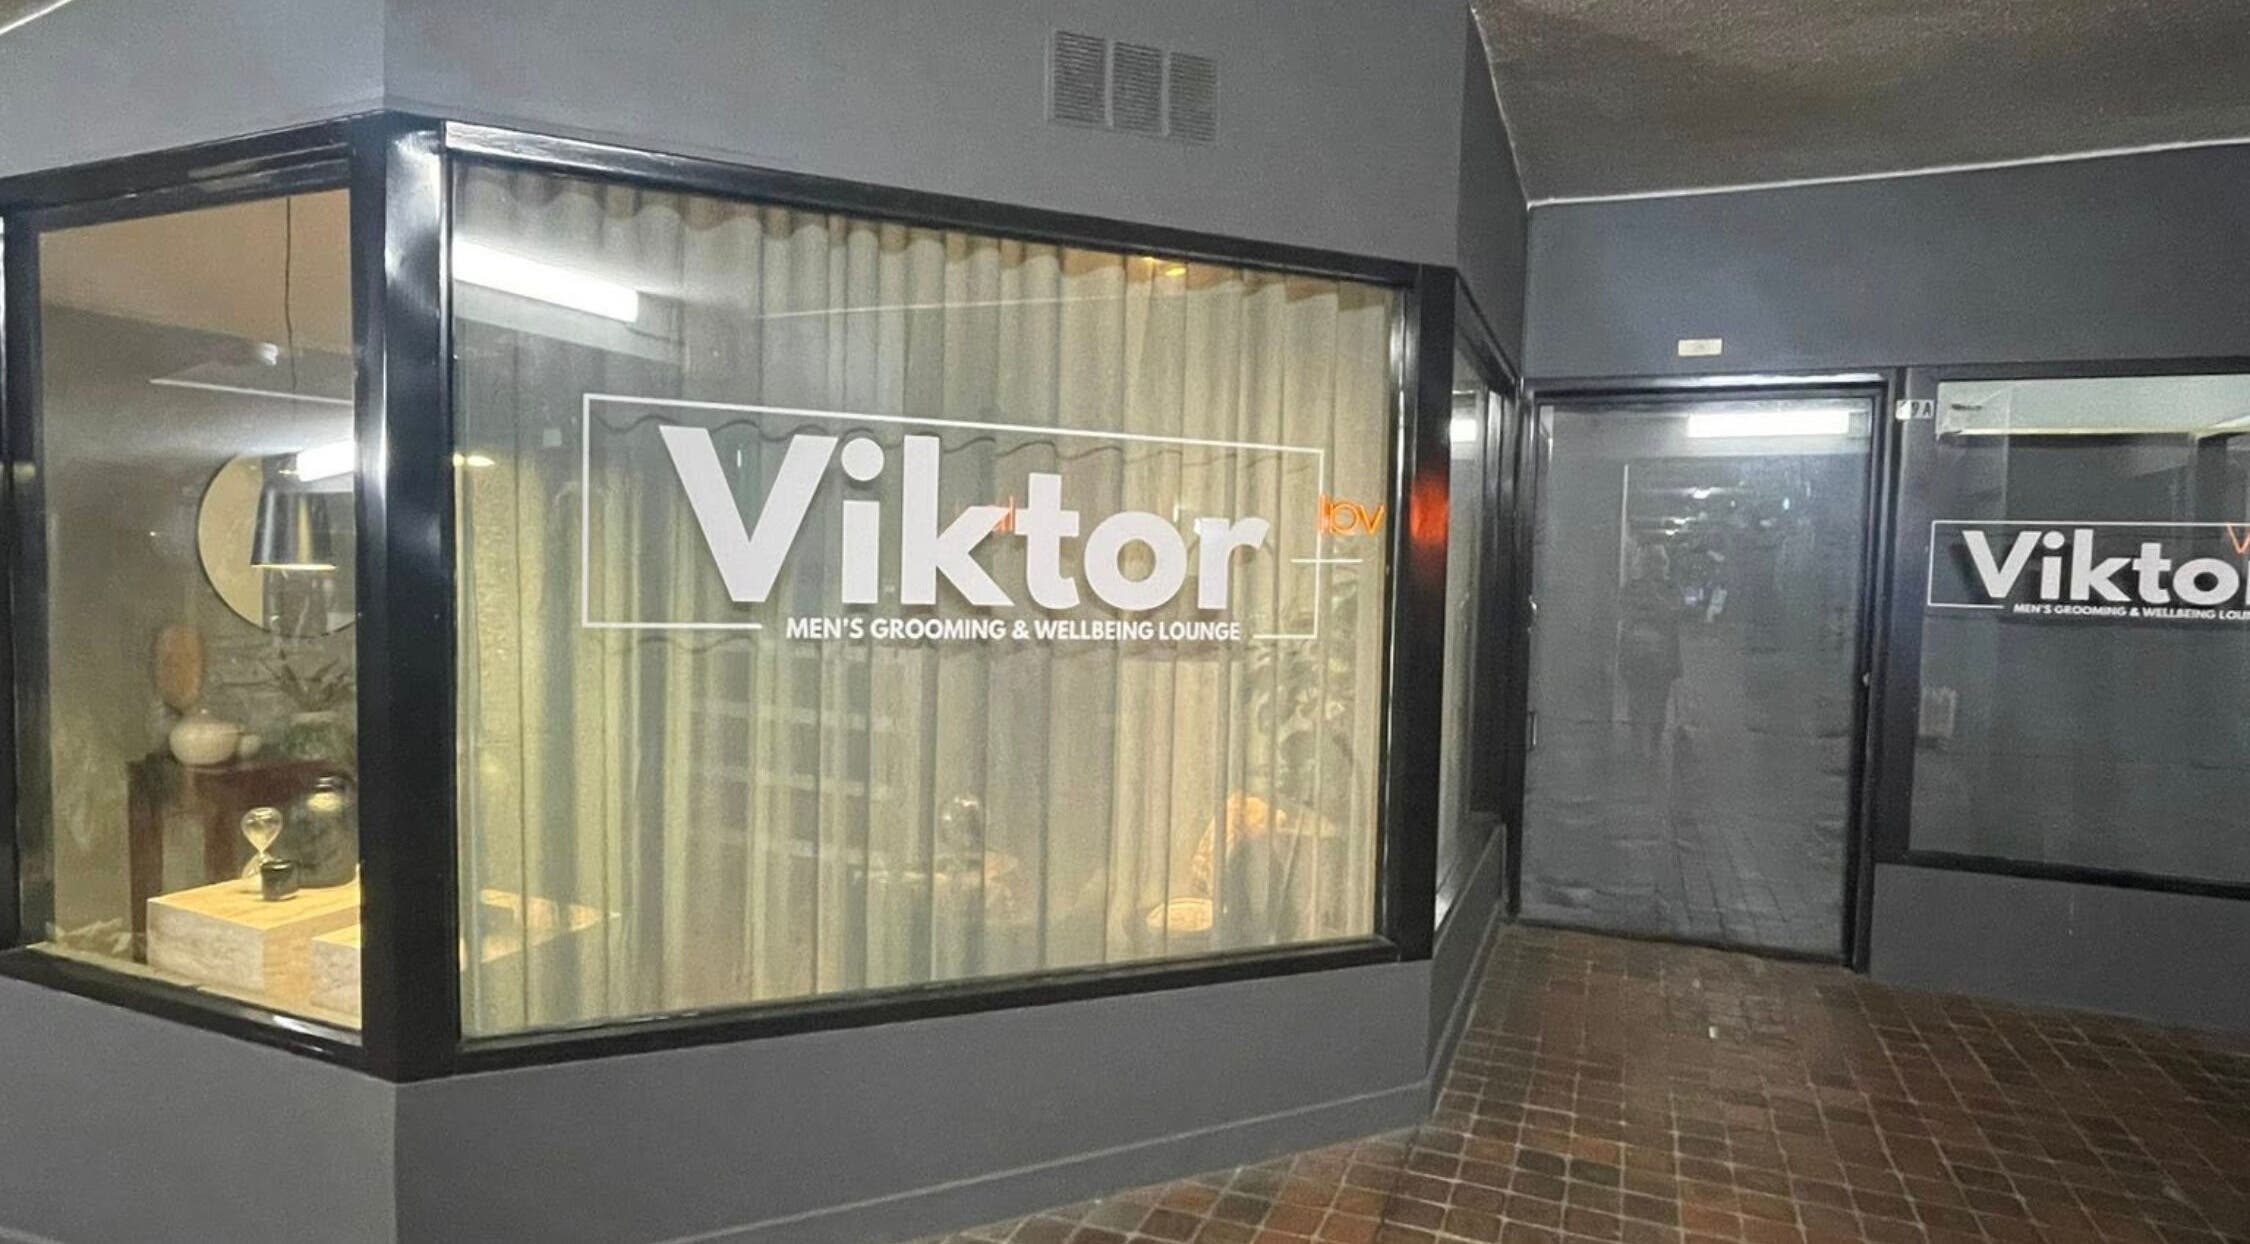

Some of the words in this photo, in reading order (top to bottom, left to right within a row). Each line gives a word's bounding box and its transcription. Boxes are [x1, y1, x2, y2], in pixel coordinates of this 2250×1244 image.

[658, 424, 1270, 611] Viktor
[1962, 529, 2250, 606] Vikto
[786, 617, 864, 639] MEN'S
[870, 618, 1007, 640] GROOMING
[1012, 620, 1030, 640] &
[1034, 620, 1153, 640] WELLBEING
[1159, 621, 1241, 641] LOUNGE
[2013, 603, 2052, 614] MEN'S
[2054, 605, 2127, 616] GROOMING
[2129, 607, 2140, 617] &
[2142, 607, 2216, 619] WELLBEING
